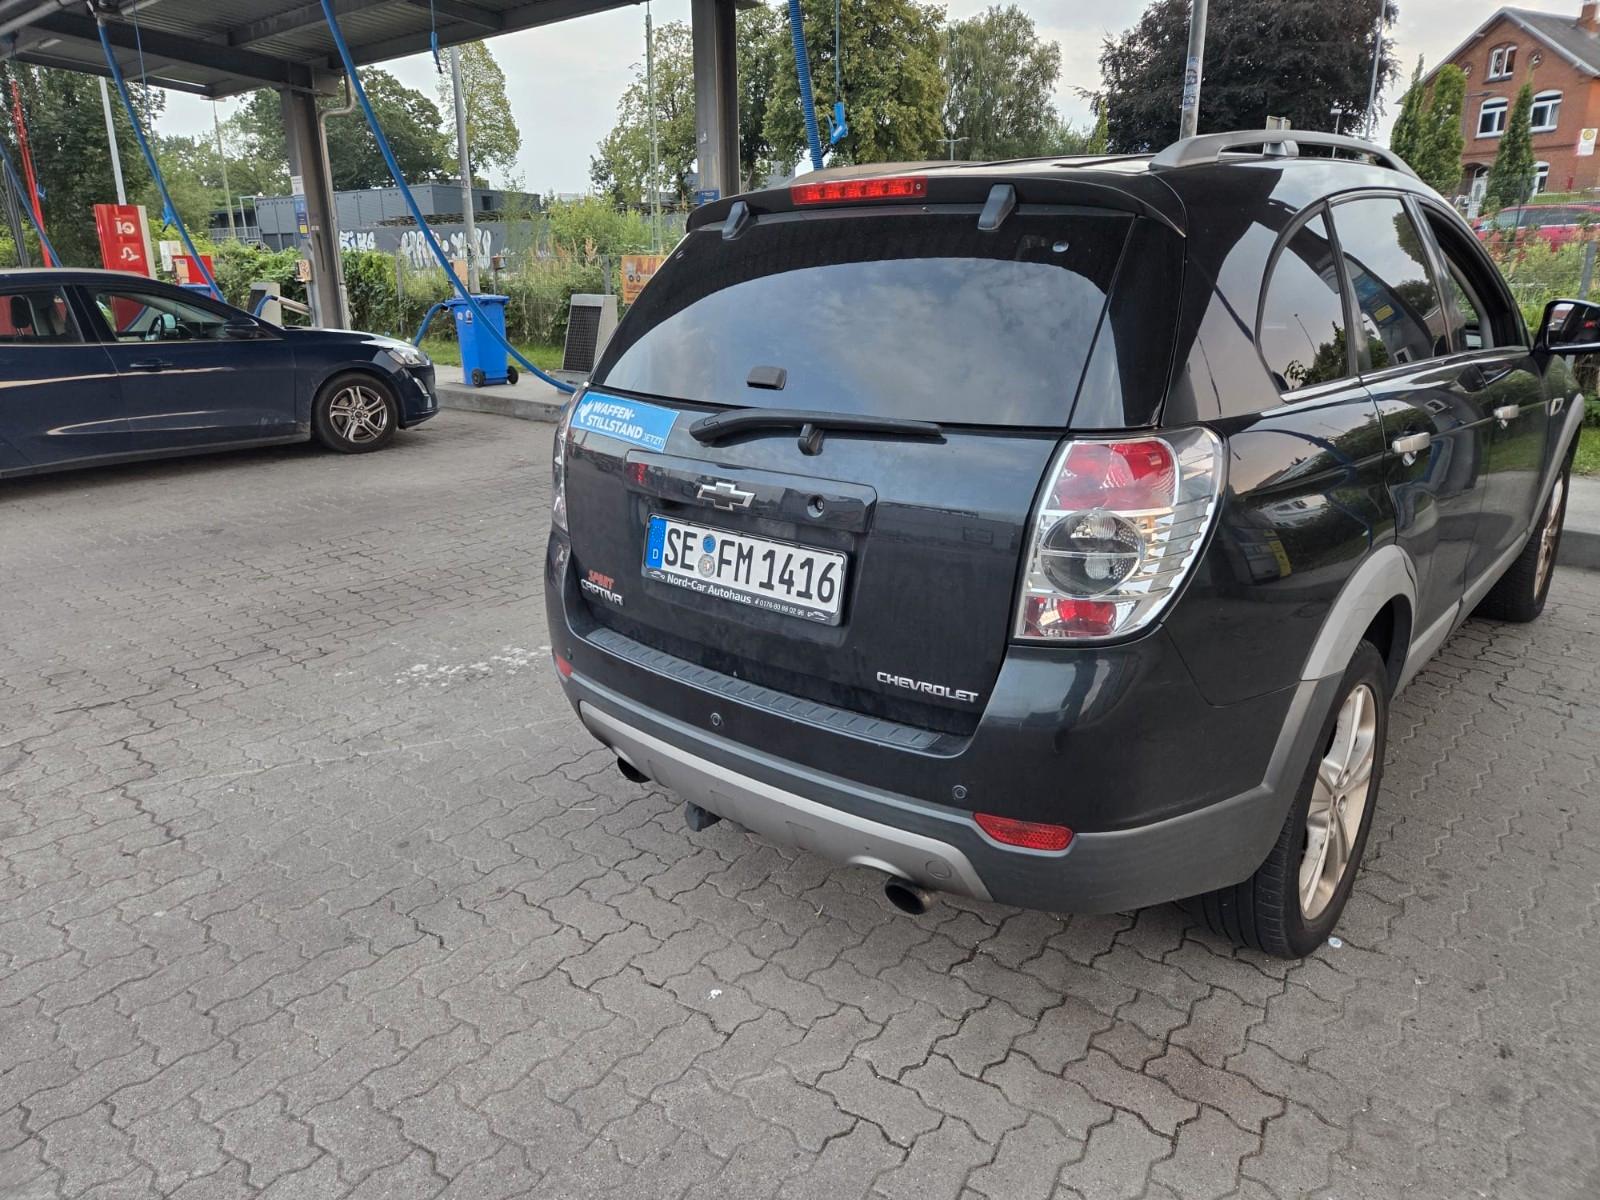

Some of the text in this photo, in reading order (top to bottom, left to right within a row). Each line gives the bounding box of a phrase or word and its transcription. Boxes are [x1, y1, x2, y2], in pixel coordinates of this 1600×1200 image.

[592, 401, 635, 421] WAFFEN-
[586, 415, 643, 439] STILLSTAND
[652, 548, 658, 560] D
[664, 528, 698, 571] SE
[759, 549, 837, 604] 1416
[581, 578, 624, 606] CAPTIVA
[588, 569, 615, 590] SPORT
[667, 573, 752, 604] Nord-Car Autohaus
[876, 671, 979, 703] CHEVROLET
